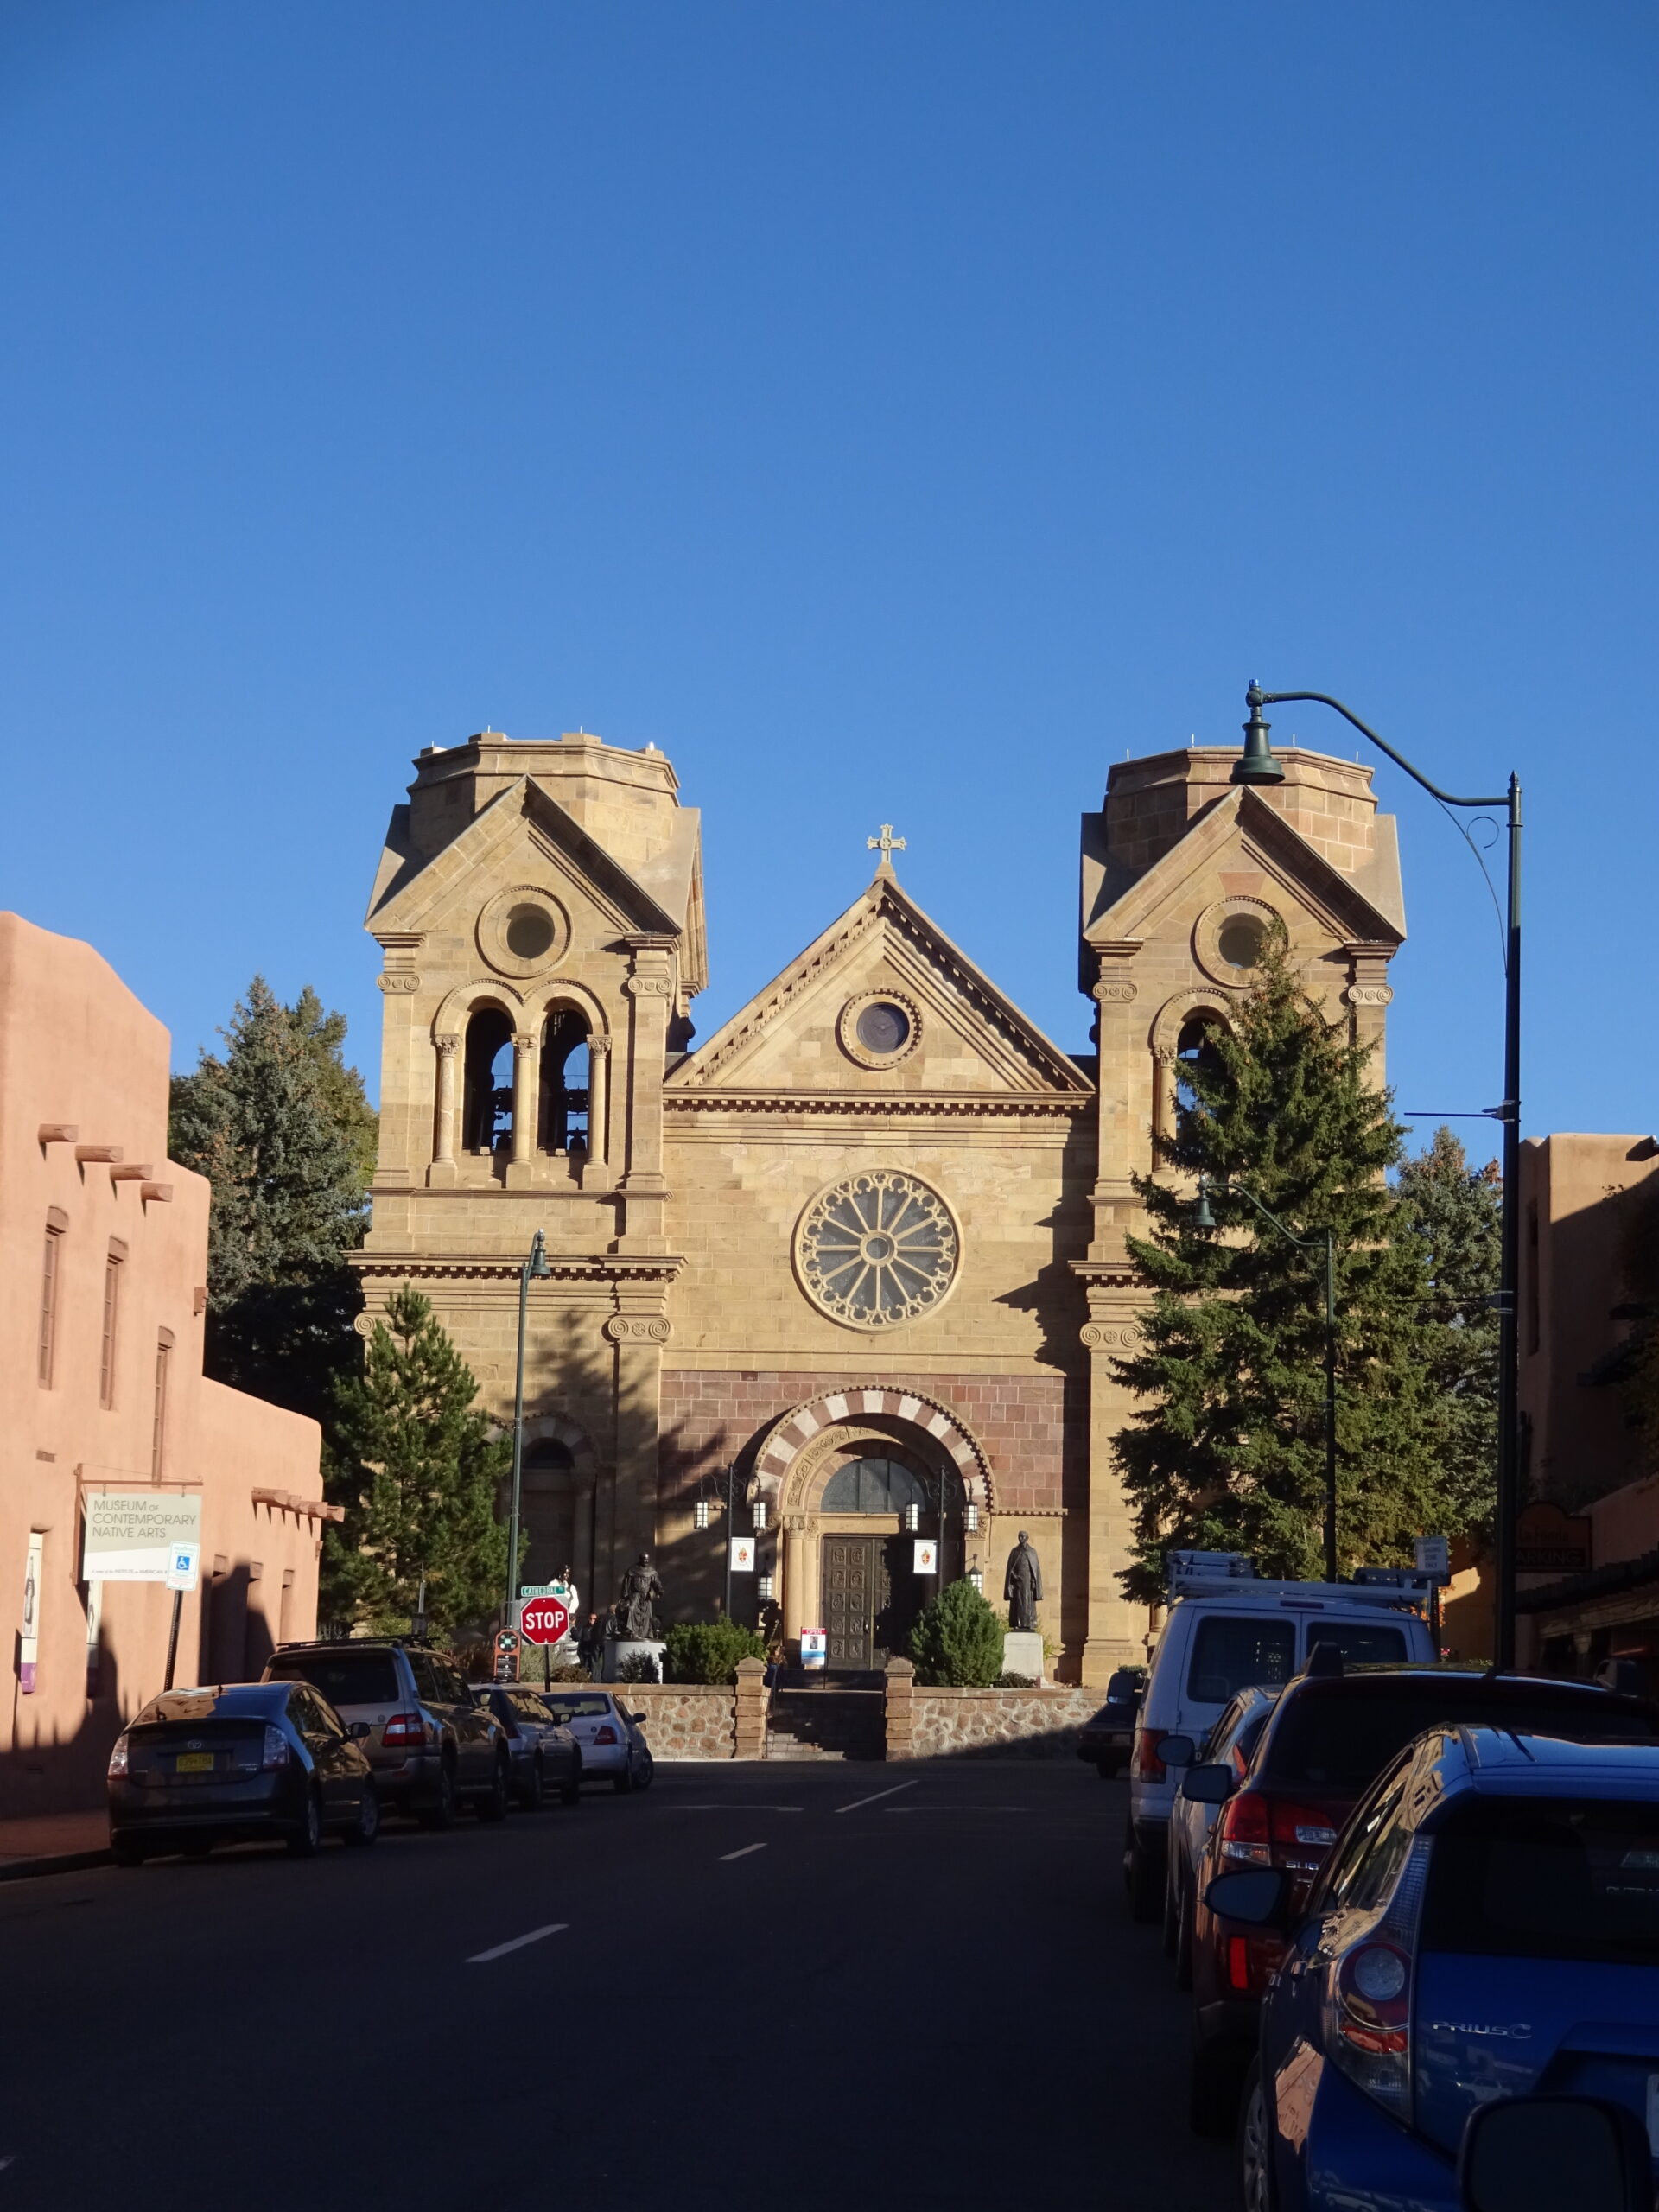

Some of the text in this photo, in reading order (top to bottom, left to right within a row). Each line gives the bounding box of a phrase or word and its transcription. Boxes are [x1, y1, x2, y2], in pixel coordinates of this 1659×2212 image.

[93, 1500, 147, 1511] MUSEUM
[92, 1513, 197, 1525] CONTEMPORARY
[92, 1527, 167, 1538] NATIVE ARTS
[1515, 1549, 1580, 1564] ARKING
[524, 1586, 556, 1596] CATHEDRAL
[525, 1611, 564, 1630] STOP
[1286, 1860, 1319, 1870] SUB
